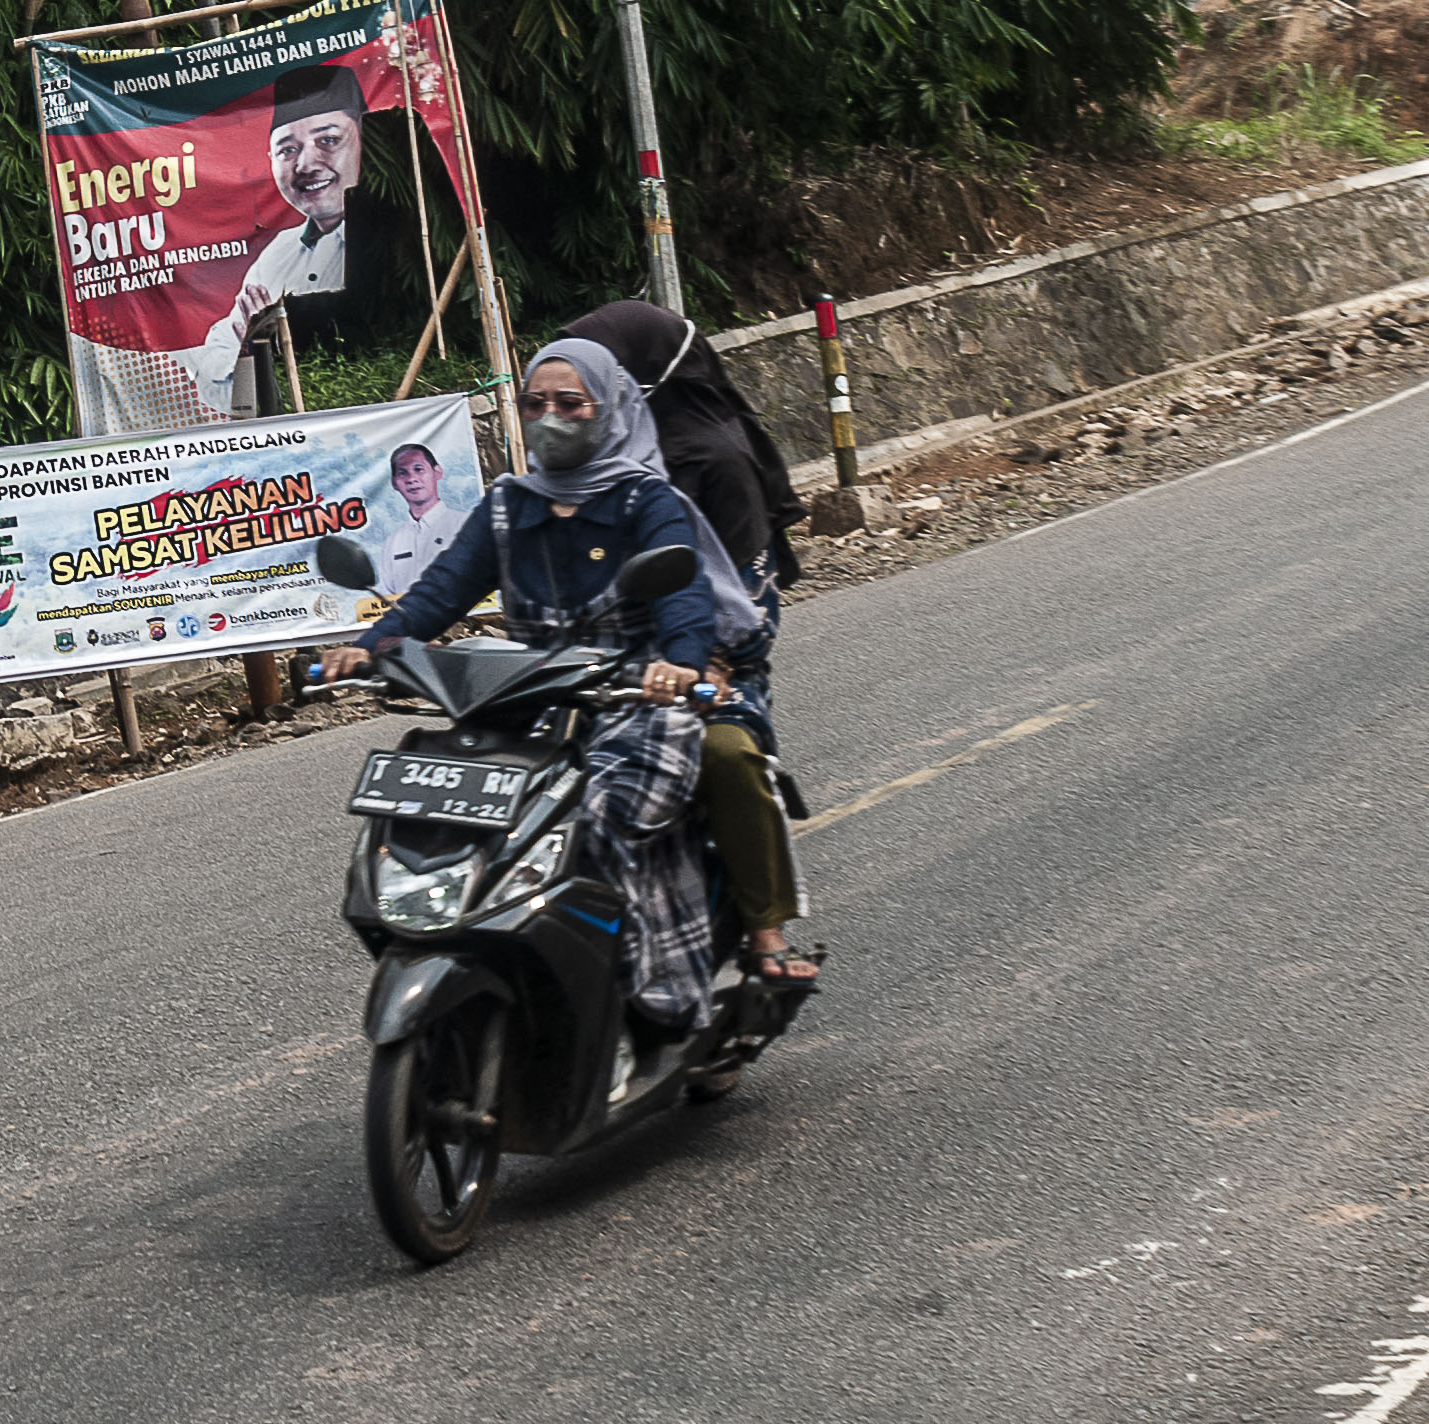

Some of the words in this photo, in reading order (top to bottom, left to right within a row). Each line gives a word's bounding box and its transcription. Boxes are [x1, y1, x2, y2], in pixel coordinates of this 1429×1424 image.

[113, 72, 171, 96] MOHON
[175, 64, 220, 86] MAAF
[224, 52, 275, 77] LAHIR
[277, 43, 314, 65] DAN
[316, 29, 368, 56] BATIN
[176, 53, 183, 66] 1
[186, 43, 238, 65] SYAWAL
[240, 36, 273, 54] 1444
[276, 31, 287, 44] H
[40, 79, 69, 93] PKB
[56, 141, 197, 214] Energi
[64, 211, 166, 267] Baru
[130, 254, 160, 273] DAN
[164, 240, 248, 266] MENGABDI
[120, 268, 174, 292] RAKYAT
[90, 446, 171, 471] DAERAH
[173, 429, 307, 460] PANDEGLANG
[92, 466, 171, 490] BANTEN
[95, 473, 313, 542] PELAYANAN
[50, 530, 198, 585] SAMSAT
[201, 497, 368, 557] KELILING
[96, 587, 120, 599] Bagi
[123, 580, 182, 597] Masyarakat
[184, 577, 209, 589] yang
[210, 570, 269, 585] membayar
[269, 562, 310, 577] PAJAK
[37, 604, 113, 622] mendapatkan
[113, 593, 175, 612] SOUVENIR
[222, 585, 257, 598] selama
[259, 578, 316, 594] persediaan
[229, 606, 308, 624] bankbanten
[401, 763, 466, 789] 3485
